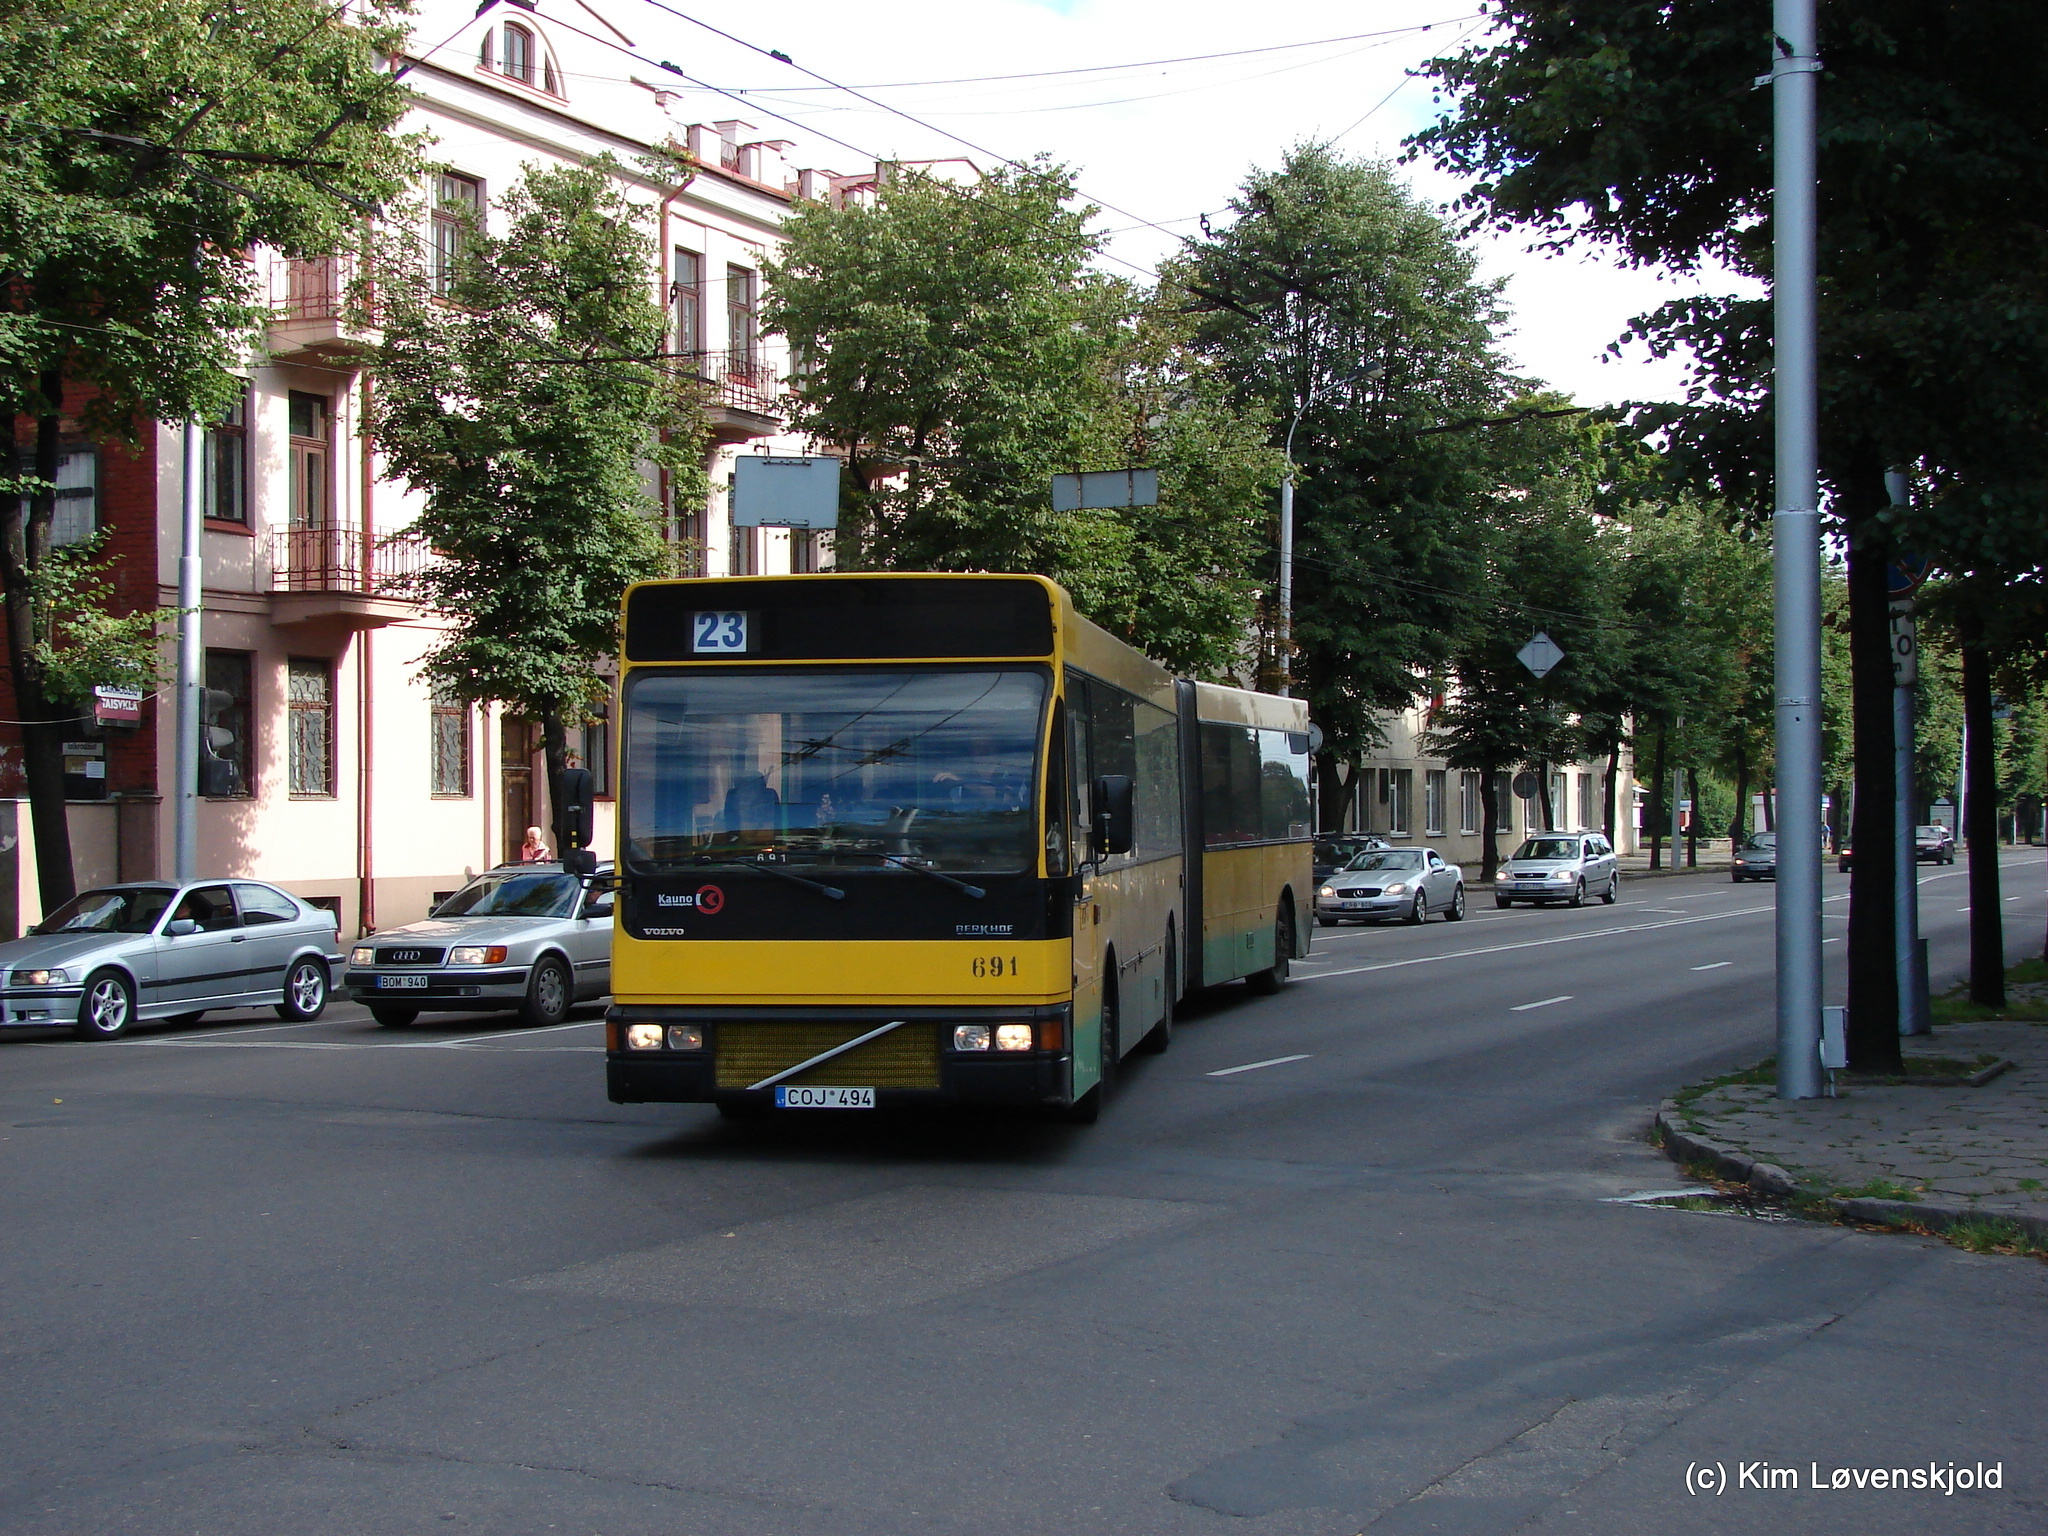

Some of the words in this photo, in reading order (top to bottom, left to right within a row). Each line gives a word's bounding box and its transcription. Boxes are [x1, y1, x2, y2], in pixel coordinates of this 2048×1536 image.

[698, 612, 743, 647] 23
[102, 697, 138, 711] TAISYKLA
[658, 894, 693, 904] Kauno
[643, 928, 685, 936] VOLVO
[956, 924, 1014, 935] BERKHOF
[972, 956, 1017, 978] 691
[382, 977, 402, 987] BOM
[408, 977, 426, 987] 940
[788, 1089, 826, 1105] COJ
[839, 1089, 871, 1106] 494
